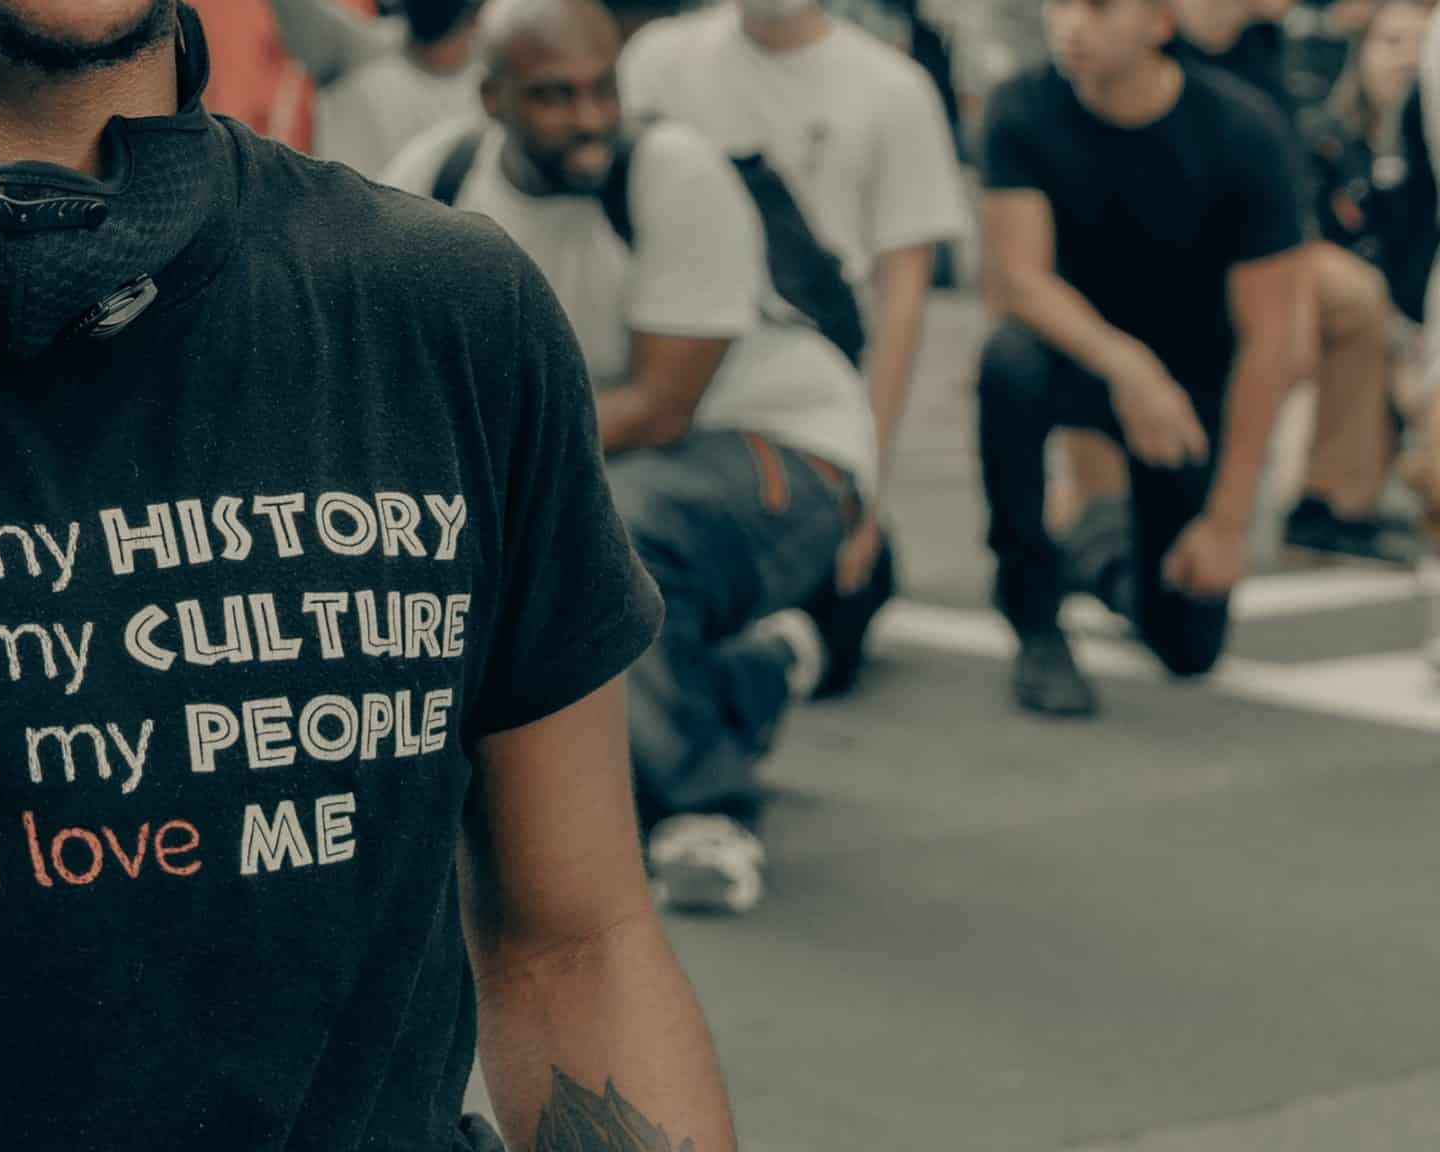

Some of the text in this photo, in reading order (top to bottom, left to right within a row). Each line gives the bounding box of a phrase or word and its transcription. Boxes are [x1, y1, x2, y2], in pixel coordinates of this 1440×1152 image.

[99, 491, 467, 575] HISTORY
[124, 589, 471, 671] CULTURE
[25, 719, 154, 794] my
[184, 687, 453, 773] PEOPLE
[23, 811, 202, 887] love
[239, 791, 356, 875] ME
